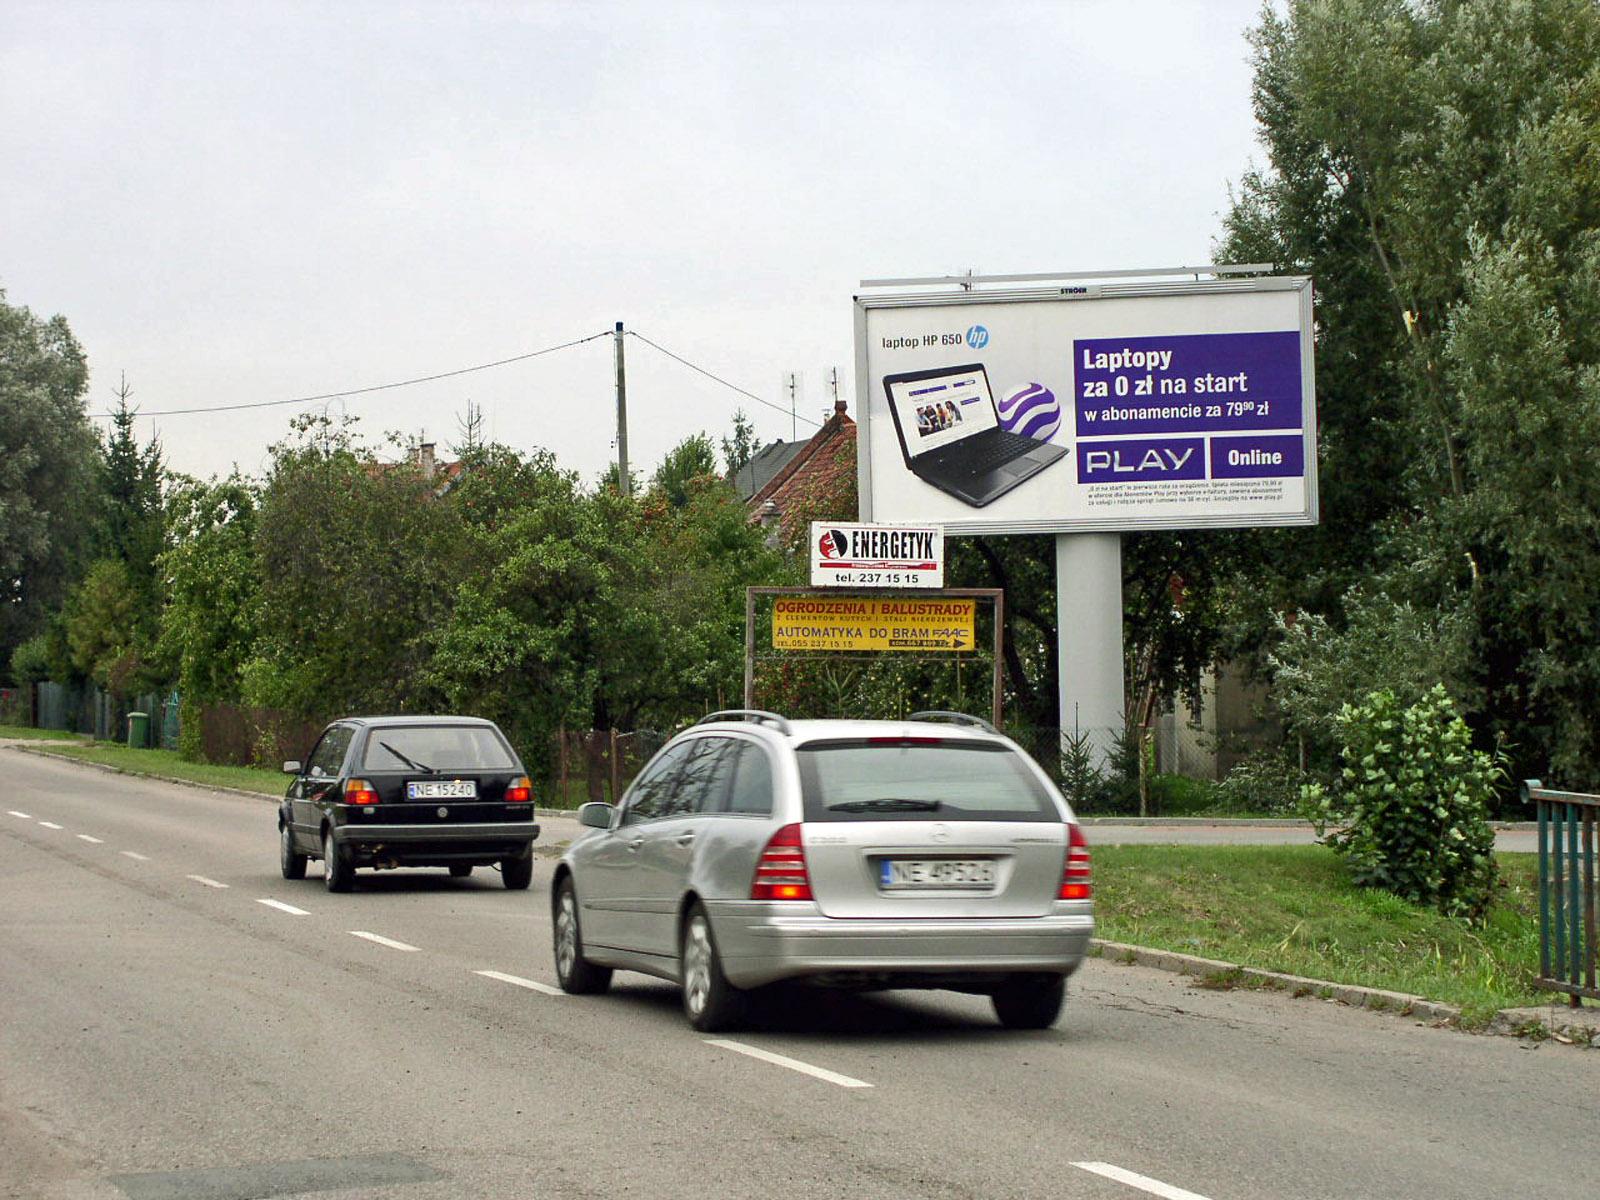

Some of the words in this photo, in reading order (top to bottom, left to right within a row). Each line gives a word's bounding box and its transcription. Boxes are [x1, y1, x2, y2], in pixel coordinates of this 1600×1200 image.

[882, 336, 919, 349] laptop
[923, 335, 938, 346] HP
[941, 333, 962, 346] 650
[967, 325, 988, 349] hp
[1083, 348, 1172, 372] Laptopy
[1083, 381, 1108, 398] za
[1115, 375, 1128, 396] 0
[1134, 375, 1153, 396] zł
[1160, 379, 1187, 394] na
[1194, 372, 1248, 393] start
[1085, 410, 1097, 422] w
[1101, 404, 1201, 421] abonamencie
[1206, 405, 1221, 417] za
[1257, 401, 1269, 416] zł
[1086, 447, 1194, 473] PLAY
[1228, 449, 1282, 466] Online
[852, 530, 933, 559] ENERGETYK
[835, 573, 855, 583] tel.
[860, 573, 881, 583] 237
[886, 574, 900, 583] 15
[905, 574, 919, 583] 15
[776, 602, 866, 615] OGRODZENIA
[871, 603, 875, 615] I
[882, 603, 971, 616] BALUSTRADY
[776, 626, 863, 639] AUTOMATYKA
[869, 627, 888, 639] DO
[892, 627, 929, 639] BRAM
[932, 628, 969, 639] FAAC
[811, 640, 825, 648] 237
[831, 640, 840, 648] 15
[843, 640, 854, 648] 15
[416, 784, 433, 796] NE
[437, 784, 473, 796] 15240
[893, 861, 923, 882] NE
